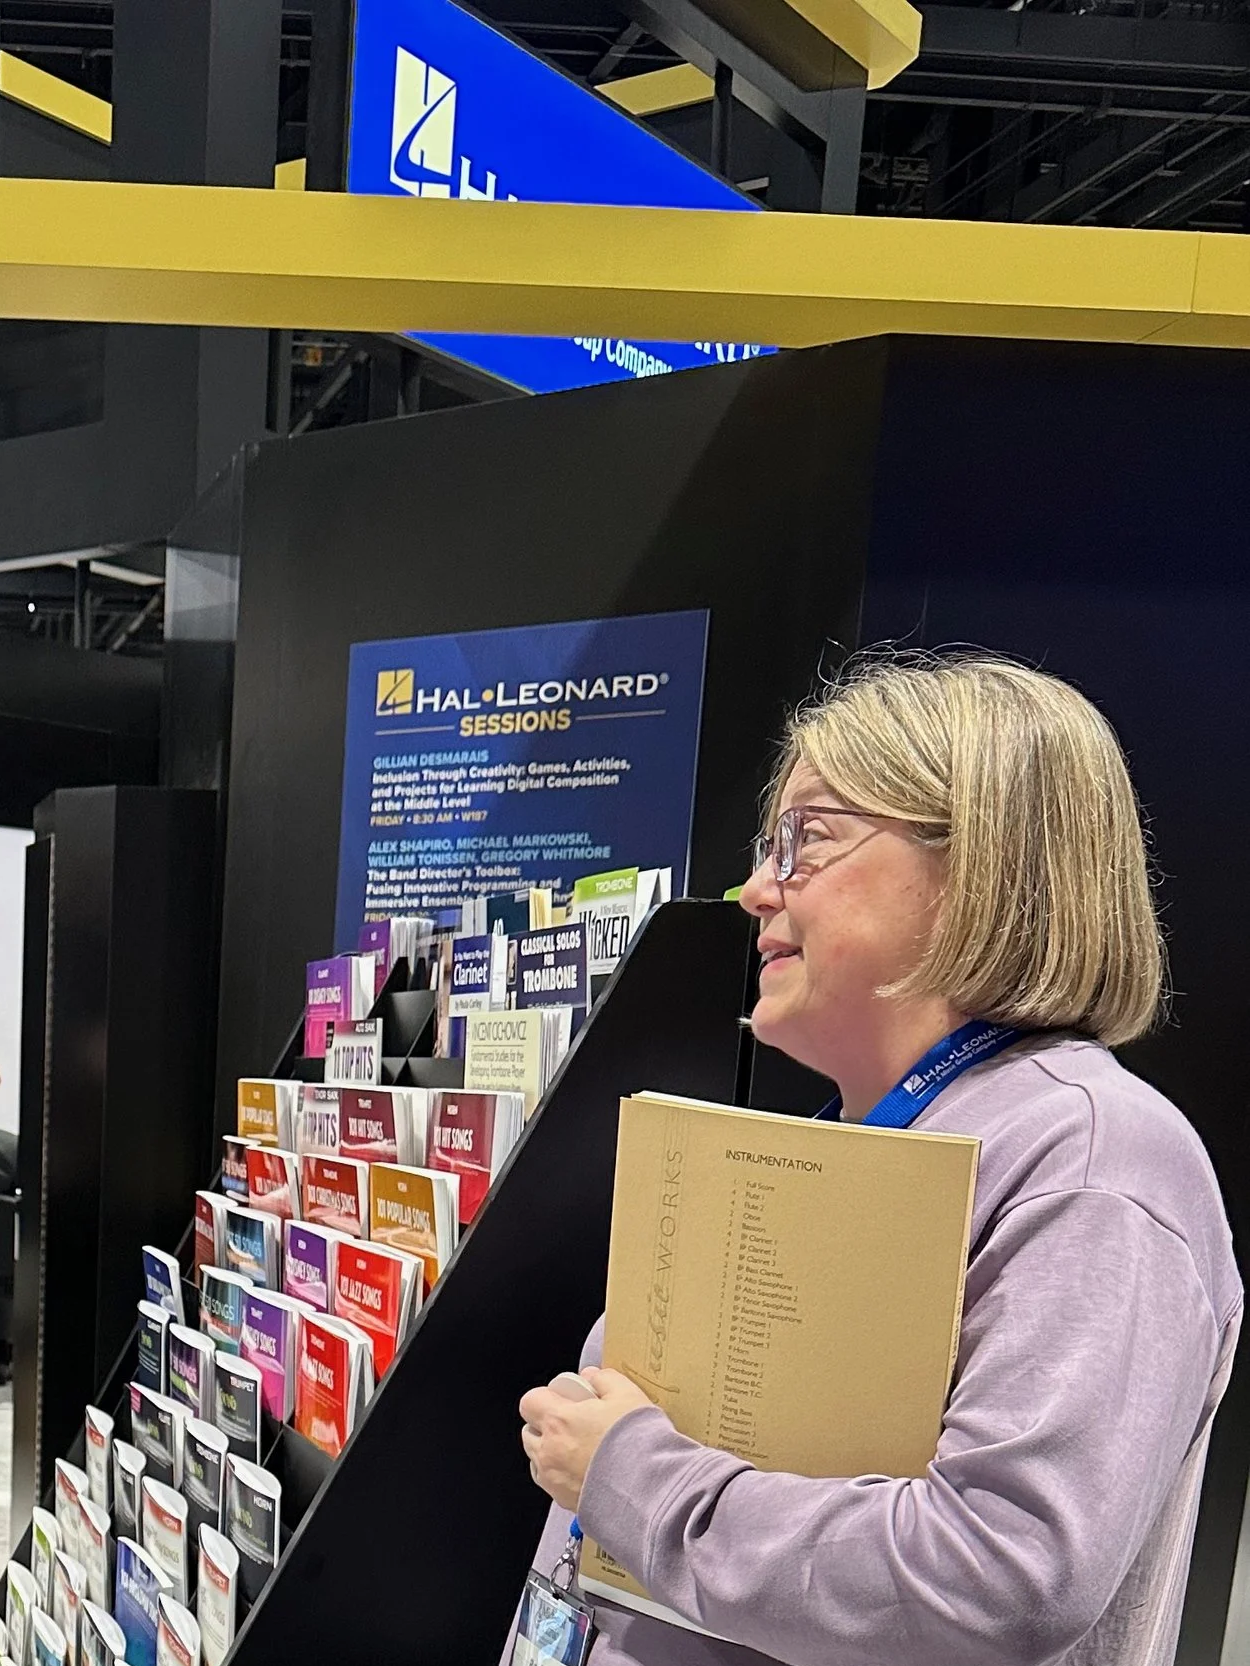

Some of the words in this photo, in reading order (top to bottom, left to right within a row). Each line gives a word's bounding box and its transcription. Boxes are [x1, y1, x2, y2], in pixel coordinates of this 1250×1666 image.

[460, 709, 571, 736] SESSIONS
[373, 754, 417, 769] GILLIAN
[420, 750, 489, 766] DESMARAIS
[373, 771, 419, 785] Inclusion
[422, 768, 467, 782] Through
[469, 763, 526, 779] Creativity:
[528, 761, 570, 775] Games,
[572, 757, 631, 772] Activities,
[372, 786, 392, 798] and
[394, 782, 437, 799] Projects
[439, 781, 455, 794] for
[457, 778, 505, 794] Learning
[507, 776, 544, 792] Digital
[547, 773, 619, 789] Composition
[371, 801, 383, 812] at
[384, 799, 402, 811] the
[404, 797, 441, 810] Middle
[442, 795, 472, 808] Level
[370, 814, 404, 826] FRIDAY
[436, 812, 452, 824] AM
[368, 840, 397, 853] ALEX
[399, 838, 454, 852] SHAPIRO,
[456, 835, 510, 849] MICHAEL
[512, 832, 592, 847] MARKOWSKI,
[368, 854, 415, 867] WILLIAM
[481, 848, 539, 863] GREGORY
[542, 846, 611, 860] WHITMORE
[367, 869, 387, 882] The
[389, 867, 417, 881] Band
[419, 865, 472, 880] Director's
[475, 865, 521, 878] Toolbox:
[366, 881, 401, 896] Fusing
[403, 879, 459, 893] Innovative
[461, 876, 537, 892] Programming
[539, 875, 562, 888] and
[365, 894, 415, 909] Immersive
[521, 934, 555, 956] CLASSICAL
[556, 930, 581, 951] SOLOS
[544, 953, 555, 966] FOR
[453, 961, 488, 986] Clarinet
[523, 965, 577, 993] TROMBONE
[355, 1046, 374, 1081] HITS
[327, 1090, 339, 1101] SAX
[318, 1112, 337, 1148] HITS
[358, 1118, 366, 1139] HIT
[366, 1119, 384, 1141] SONGS
[441, 1126, 451, 1149] HIT
[451, 1127, 474, 1152] SONGS
[725, 1149, 823, 1173] INSTRUMENTATION
[746, 1181, 757, 1189] Full
[387, 1199, 412, 1227] POPULAR
[412, 1207, 431, 1233] SONGS
[743, 1212, 761, 1222] Oboe
[744, 1277, 757, 1285] Alto
[758, 1278, 792, 1291] Saxophone
[349, 1278, 362, 1304] JAZZ
[362, 1282, 383, 1312] SONGS
[743, 1287, 756, 1295] Alto
[757, 1289, 792, 1301] Saxophone
[742, 1296, 761, 1306] Tenor
[762, 1300, 797, 1312] Saxophone
[740, 1317, 766, 1328] Trumpet
[767, 1312, 802, 1324] Saxophone
[739, 1327, 765, 1338] Trumpet
[258, 1331, 276, 1358] SONGS
[733, 1347, 749, 1355] Horn
[738, 1337, 764, 1348] Trumpet
[727, 1355, 759, 1368] Trombone
[317, 1363, 334, 1391] SONGS
[726, 1365, 758, 1377] Trombone
[229, 1375, 255, 1392] TRUMPET
[723, 1394, 738, 1403] Tuba
[253, 1496, 272, 1513] HORN
